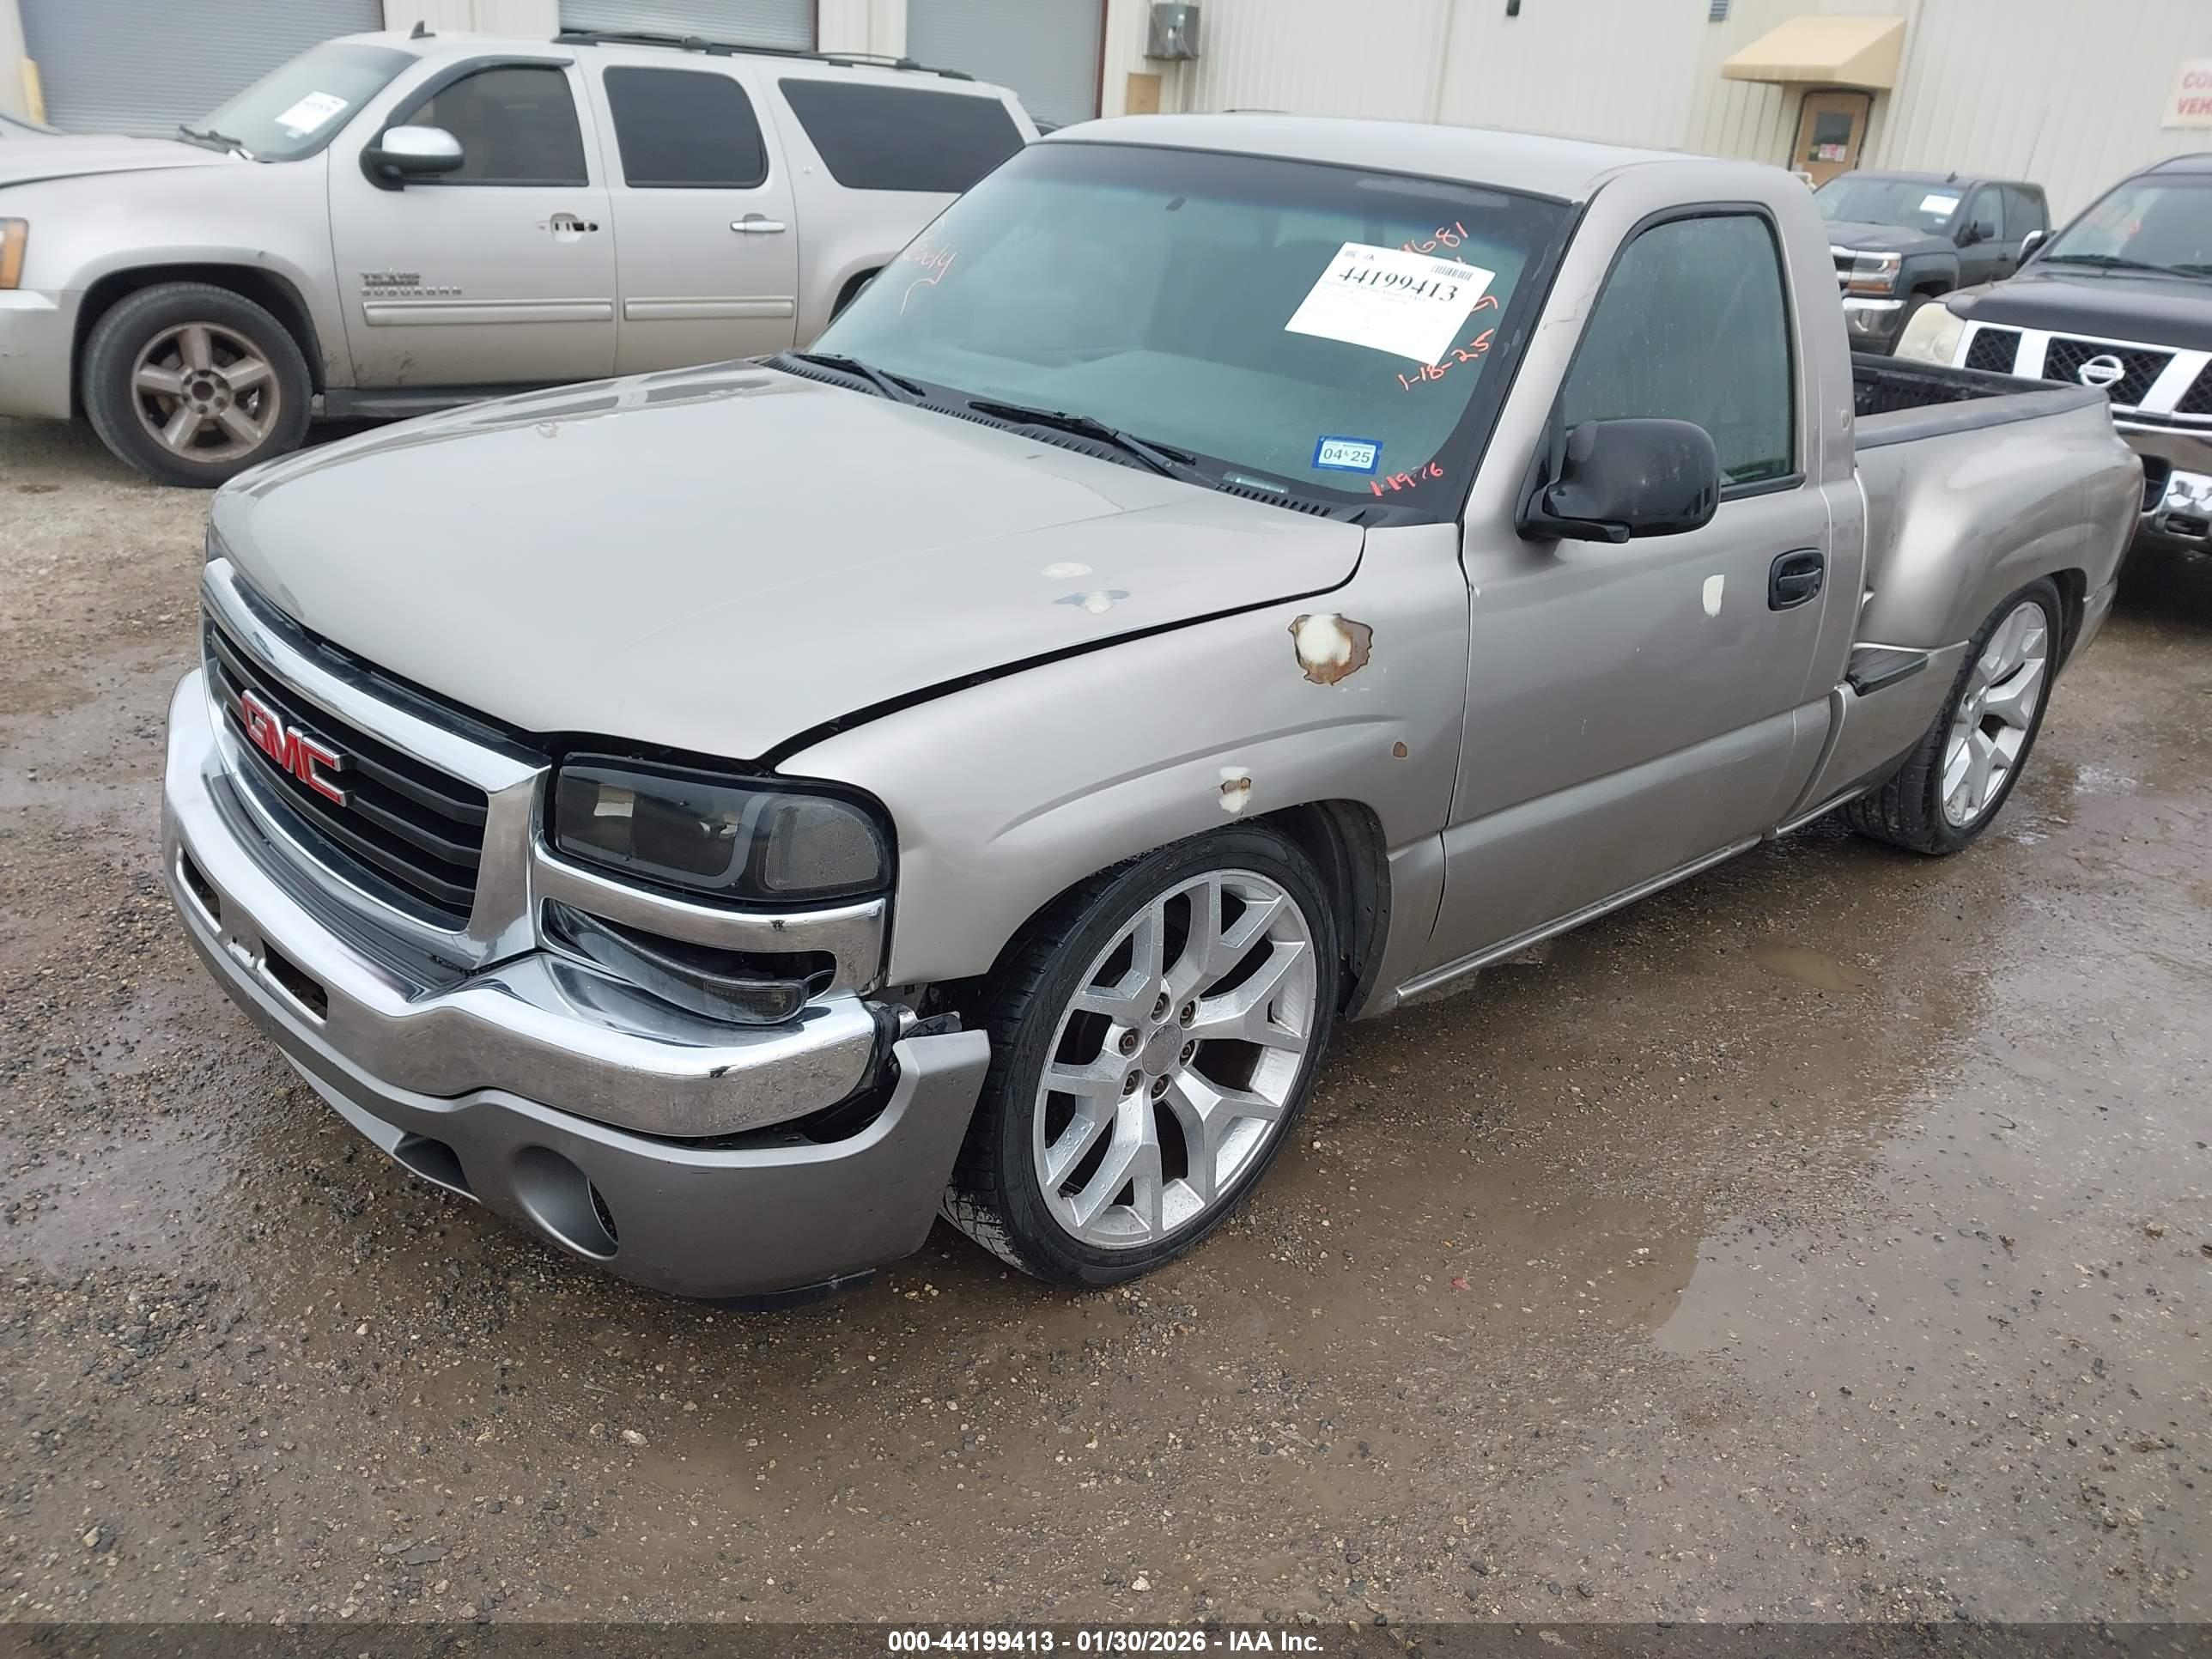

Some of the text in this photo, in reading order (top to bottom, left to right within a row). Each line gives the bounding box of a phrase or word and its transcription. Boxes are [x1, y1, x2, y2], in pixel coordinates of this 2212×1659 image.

[362, 286, 463, 296] SUBURBAN
[1338, 265, 1459, 302] 44199413
[1323, 447, 1371, 464] 04 25
[241, 690, 347, 807] GMC
